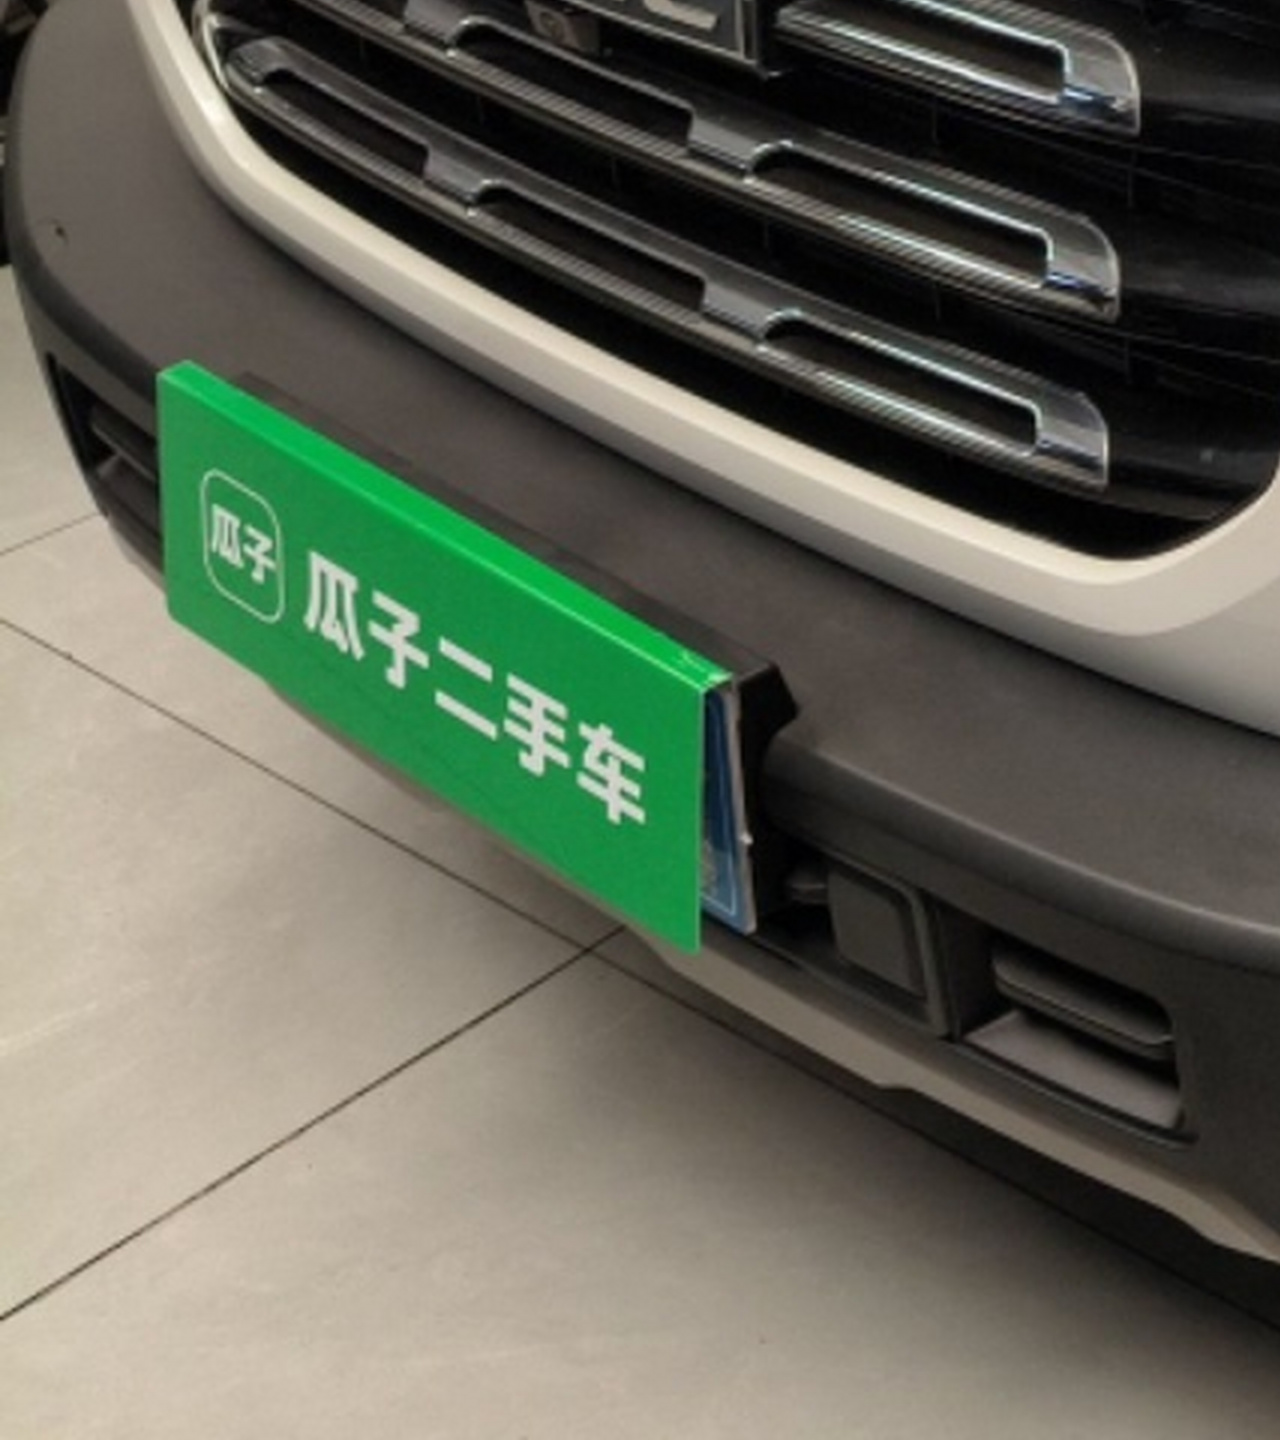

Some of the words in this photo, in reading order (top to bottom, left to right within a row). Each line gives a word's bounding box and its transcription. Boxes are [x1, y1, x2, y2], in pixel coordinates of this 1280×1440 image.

[210, 503, 276, 585] 瓜子
[304, 550, 646, 826] 瓜子二手车
